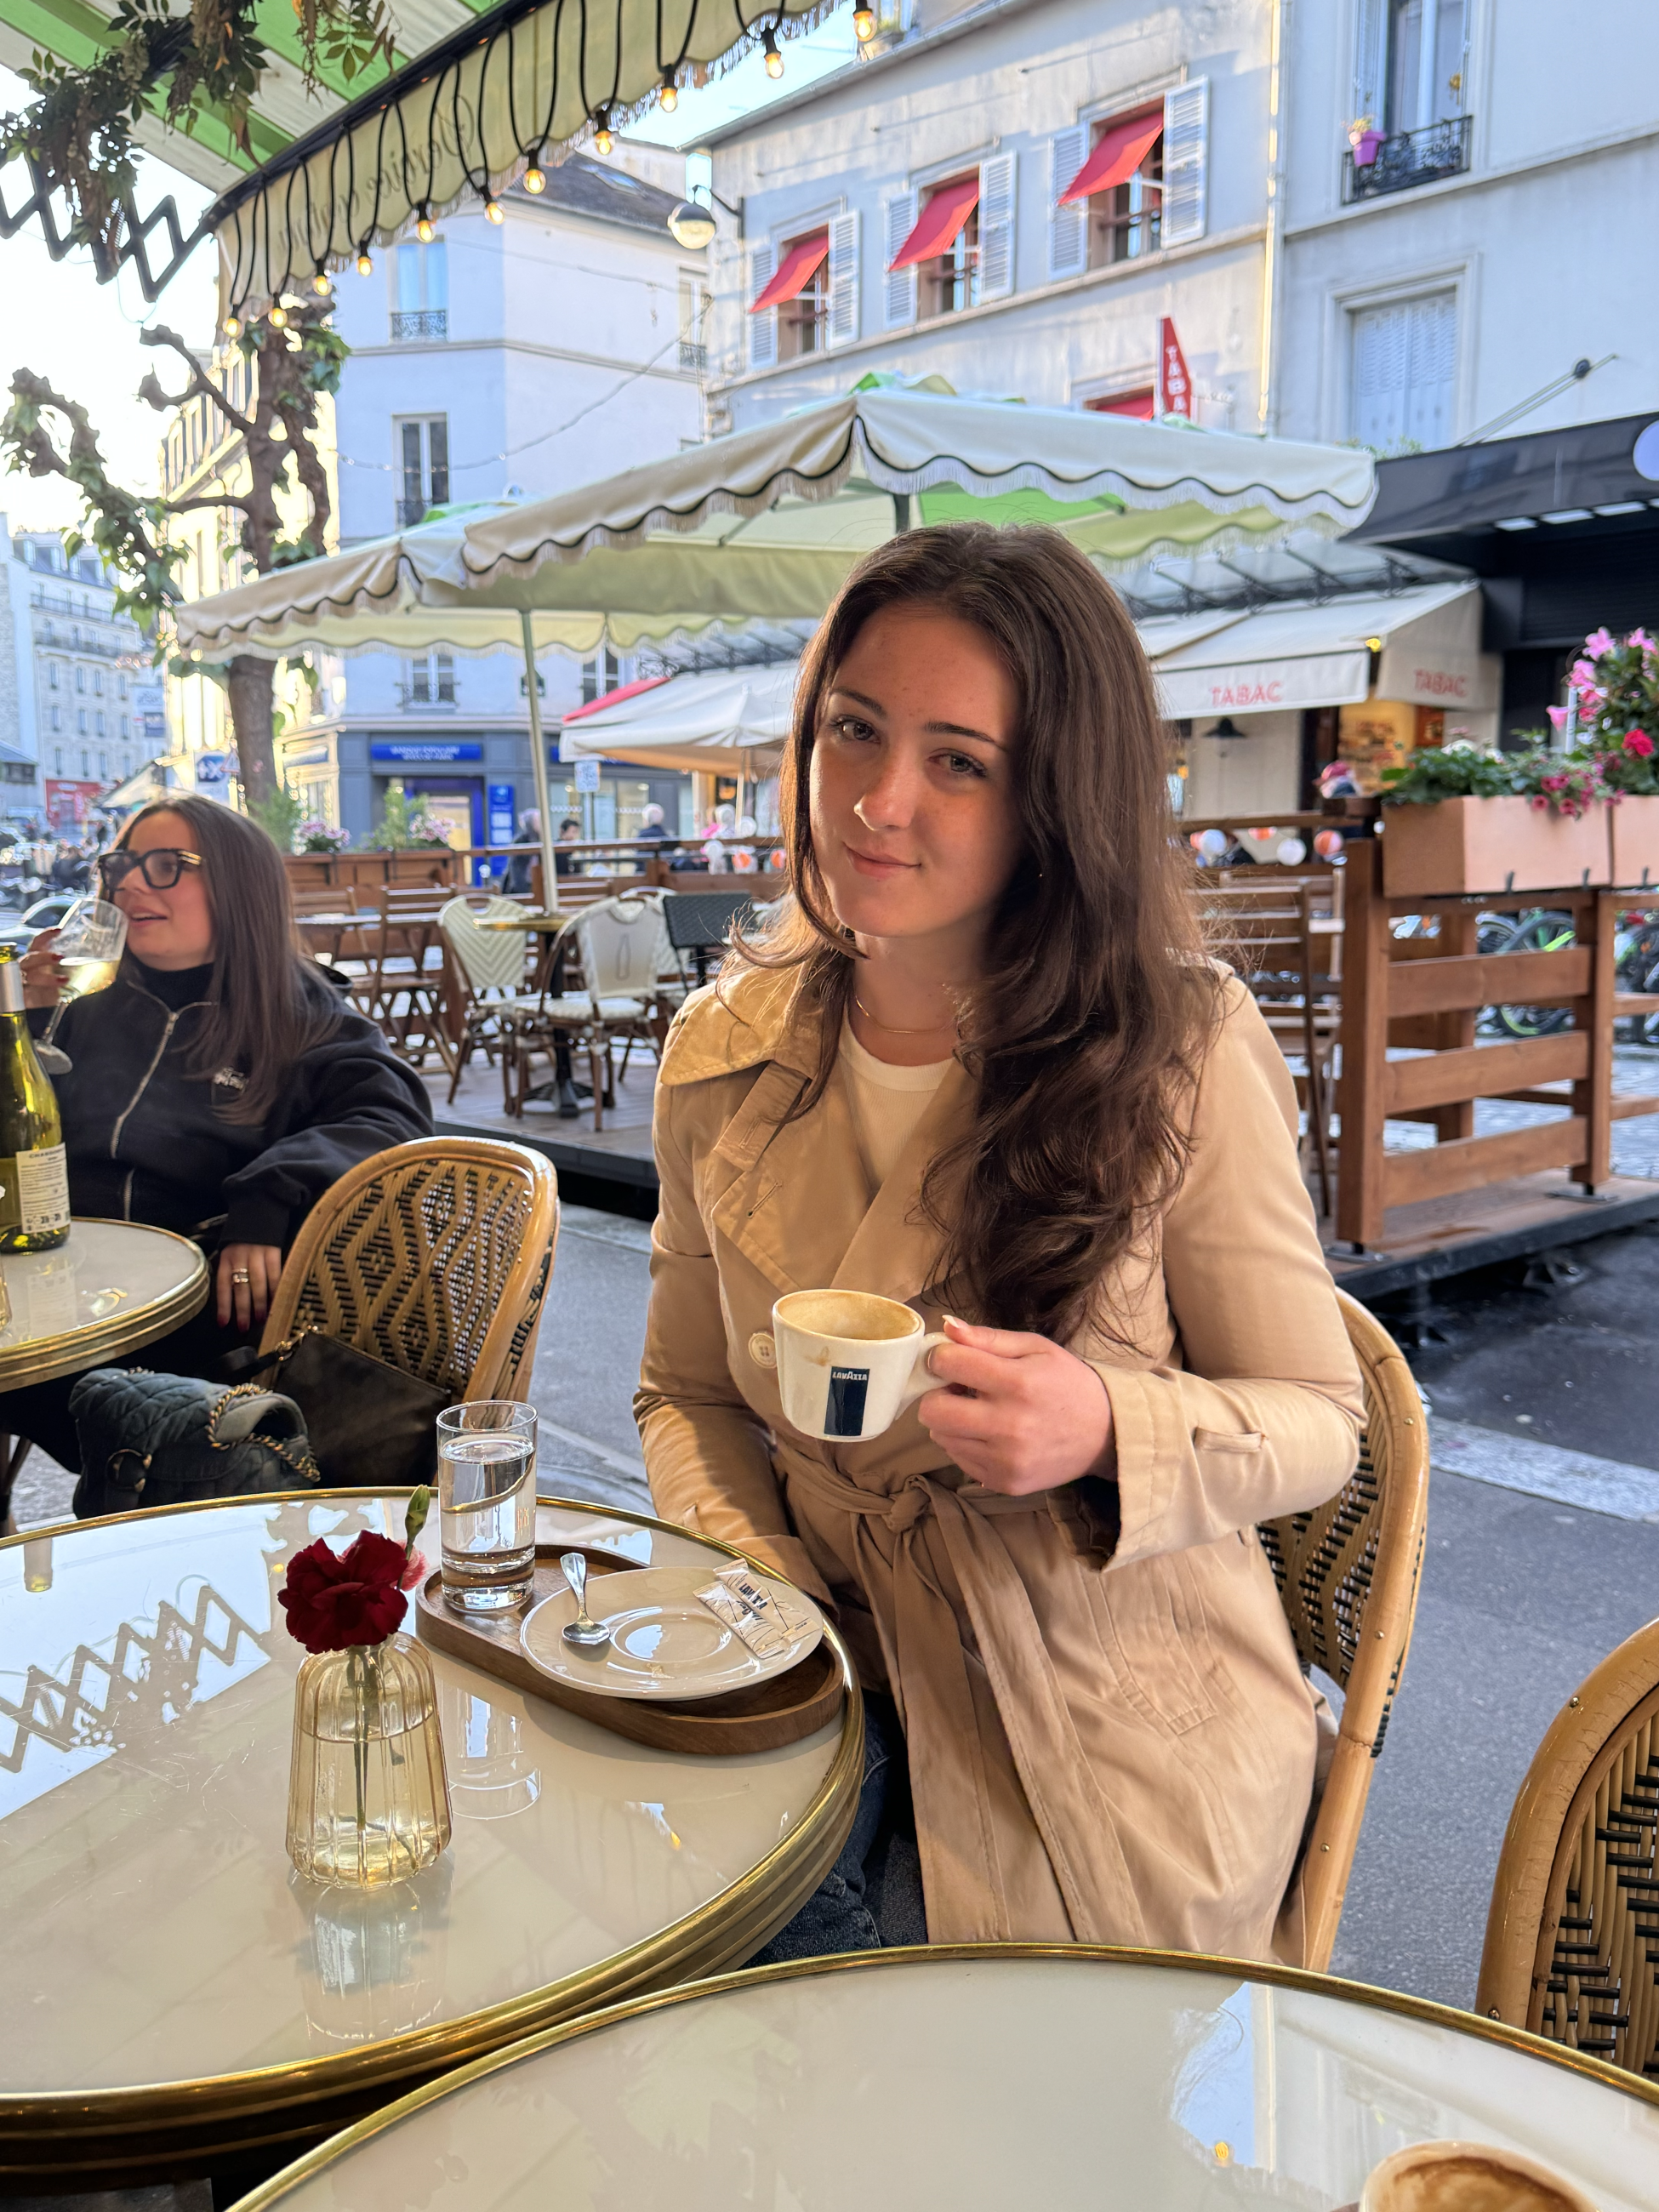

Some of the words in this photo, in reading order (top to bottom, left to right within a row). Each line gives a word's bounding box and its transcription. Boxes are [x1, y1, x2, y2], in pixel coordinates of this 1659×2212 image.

[1166, 345, 1188, 412] TABA
[1210, 681, 1284, 706] TABAC
[1413, 669, 1468, 698] TABAC
[832, 1371, 868, 1381] LAVAZZA
